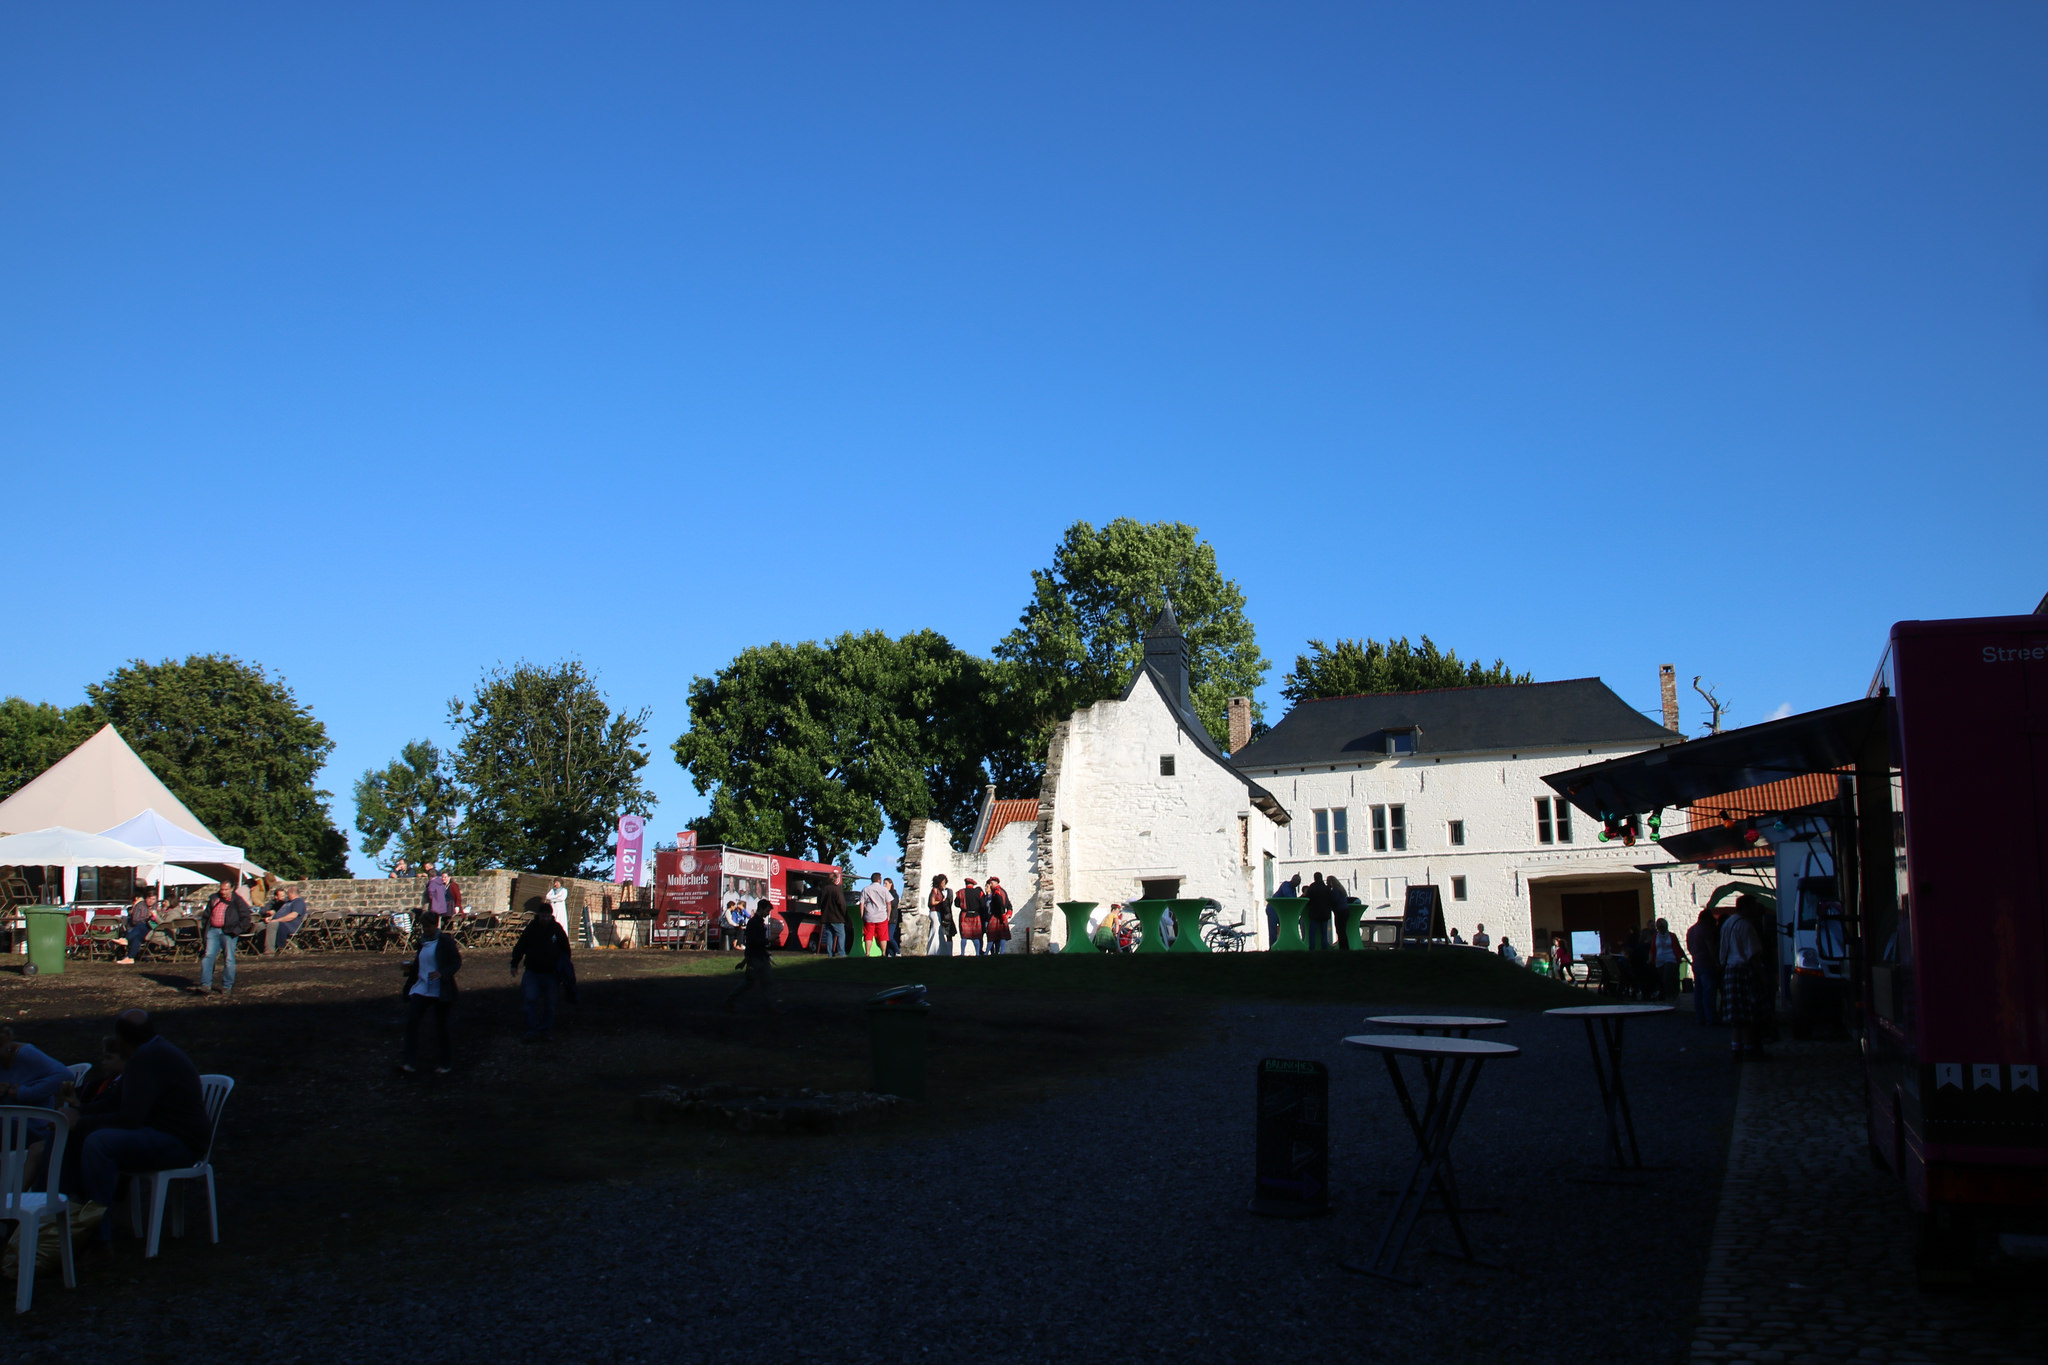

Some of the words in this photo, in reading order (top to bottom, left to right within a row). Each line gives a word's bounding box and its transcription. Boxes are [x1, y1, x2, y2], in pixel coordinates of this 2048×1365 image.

[1981, 645, 2048, 663] Stree
[623, 848, 637, 865] 21
[667, 873, 709, 886] Mobichefs
[1409, 890, 1433, 905] FISH
[1404, 916, 1429, 931] CHIPS
